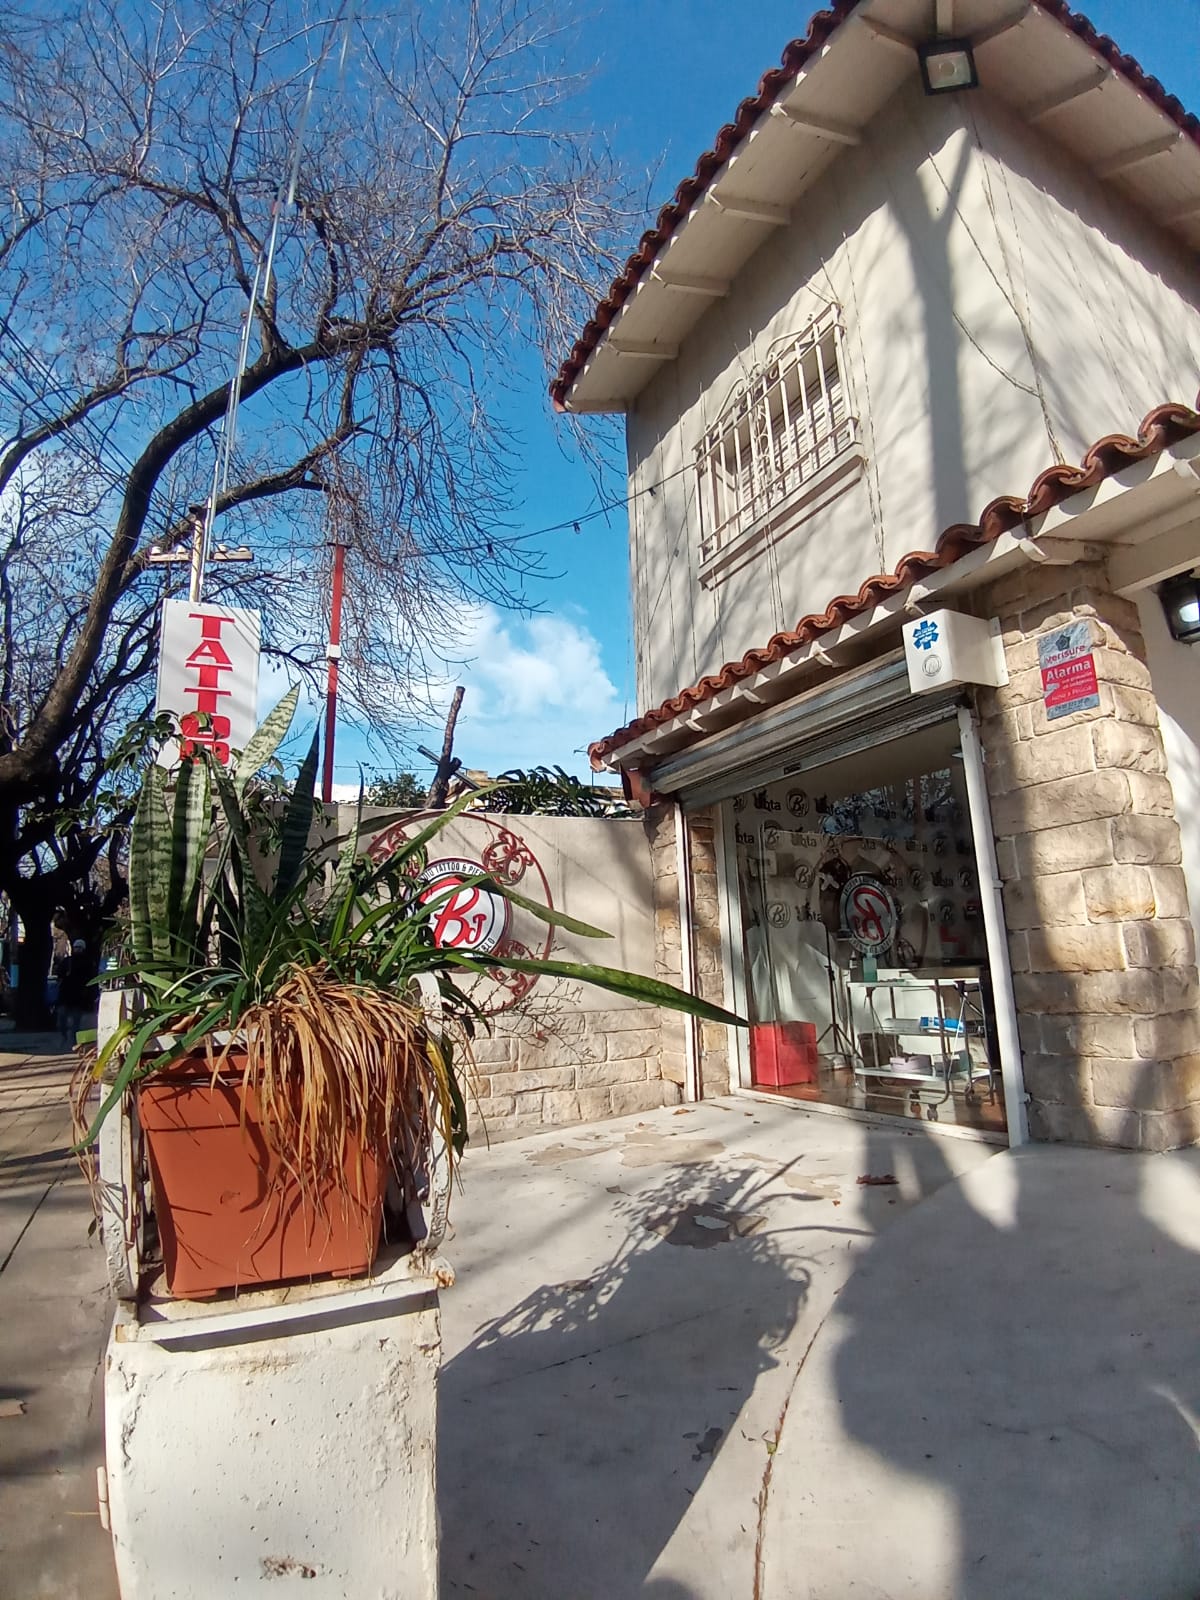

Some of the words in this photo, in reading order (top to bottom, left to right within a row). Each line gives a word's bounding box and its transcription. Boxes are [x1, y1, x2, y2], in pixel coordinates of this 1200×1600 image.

[1045, 645, 1086, 663] verisure
[1046, 660, 1091, 682] Alarma
[436, 862, 460, 874] TATTOO
